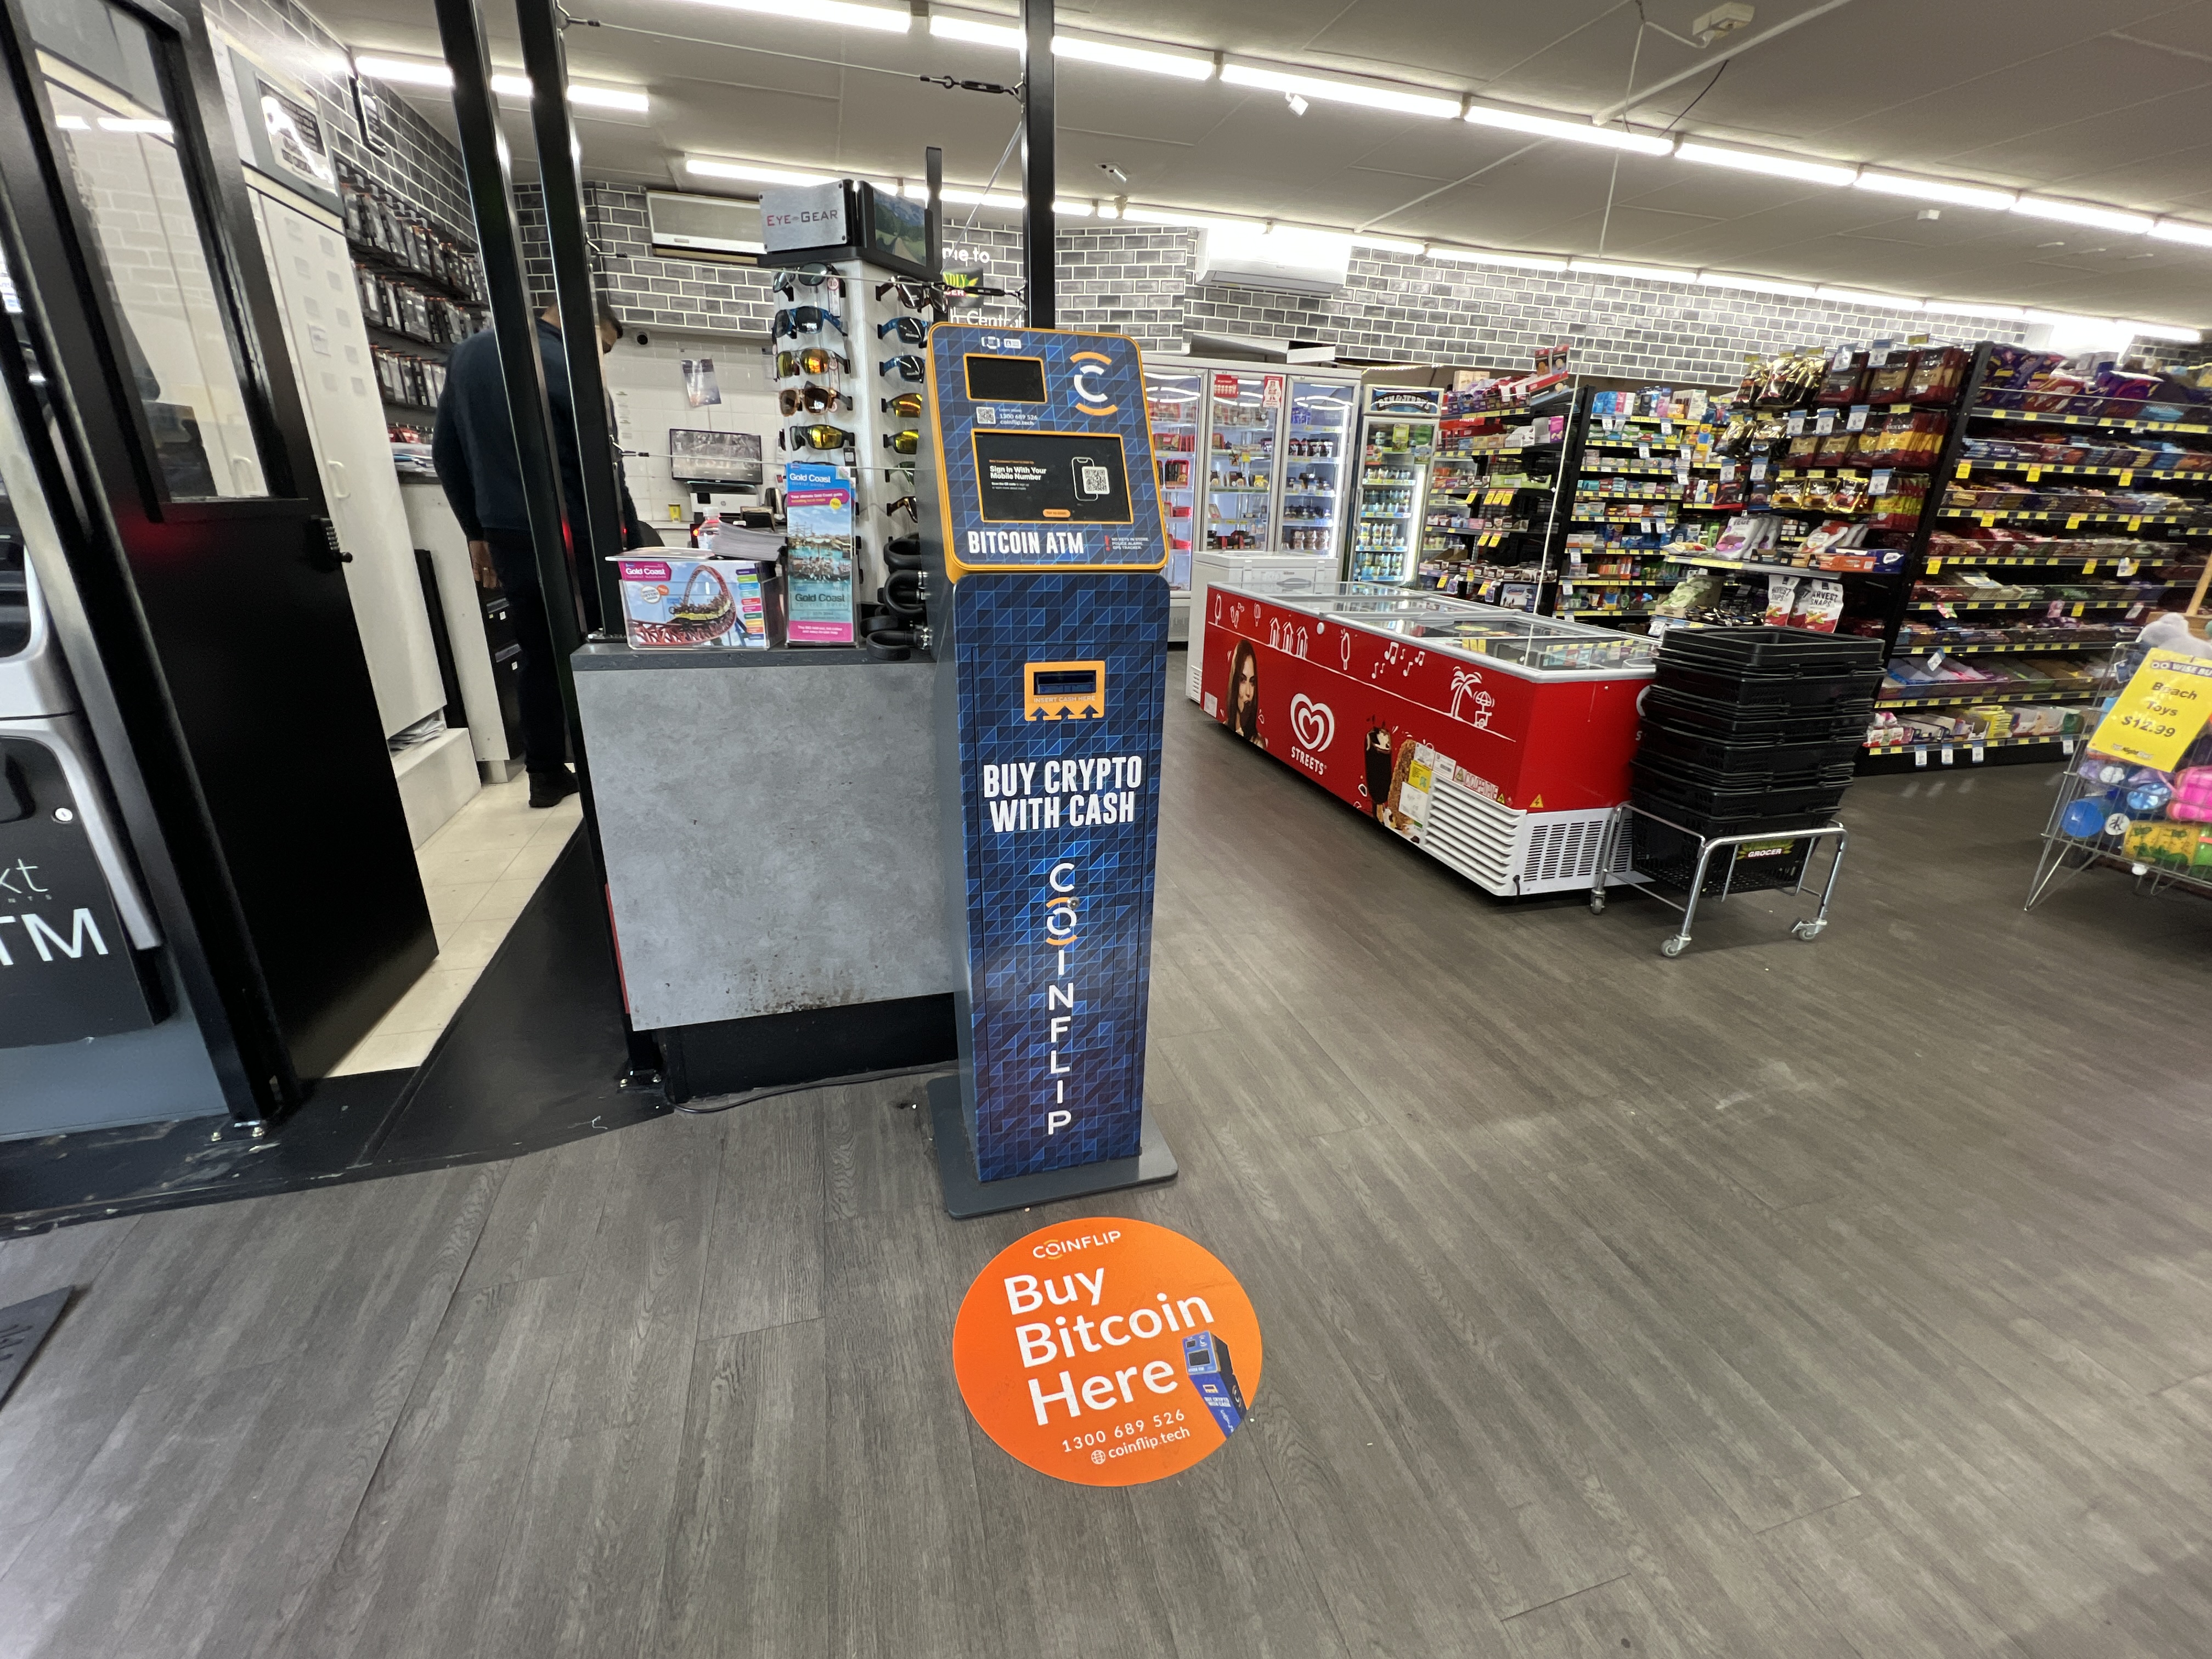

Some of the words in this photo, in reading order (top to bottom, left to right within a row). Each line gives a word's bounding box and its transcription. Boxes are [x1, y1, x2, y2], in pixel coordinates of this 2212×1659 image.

[973, 247, 990, 263] to
[789, 473, 808, 482] Gold
[809, 474, 831, 483] Coast
[989, 465, 1006, 473] Sign
[968, 531, 1041, 554] BITCOIN
[1046, 532, 1084, 554] ATM
[795, 594, 816, 602] Gold
[819, 594, 845, 602] Coast
[2171, 662, 2198, 674] WISE
[2152, 682, 2198, 700] Beach
[2146, 701, 2178, 716] Toys
[2121, 715, 2176, 737] $12.99
[984, 762, 1036, 798] BUY
[1045, 755, 1142, 794] CRYPTO
[990, 796, 1060, 833] WITH
[1070, 791, 1135, 827] CASH
[1748, 848, 1782, 857] GROCER
[1032, 1230, 1121, 1260] COINFLIP
[1004, 1267, 1104, 1316] Buy
[1015, 1292, 1215, 1369] Bitcoin
[1028, 1359, 1178, 1426] Here
[1062, 1430, 1107, 1453] 1300
[1114, 1419, 1145, 1438] 689
[1153, 1409, 1185, 1428] 526
[1108, 1425, 1190, 1459] coinflip.tech
